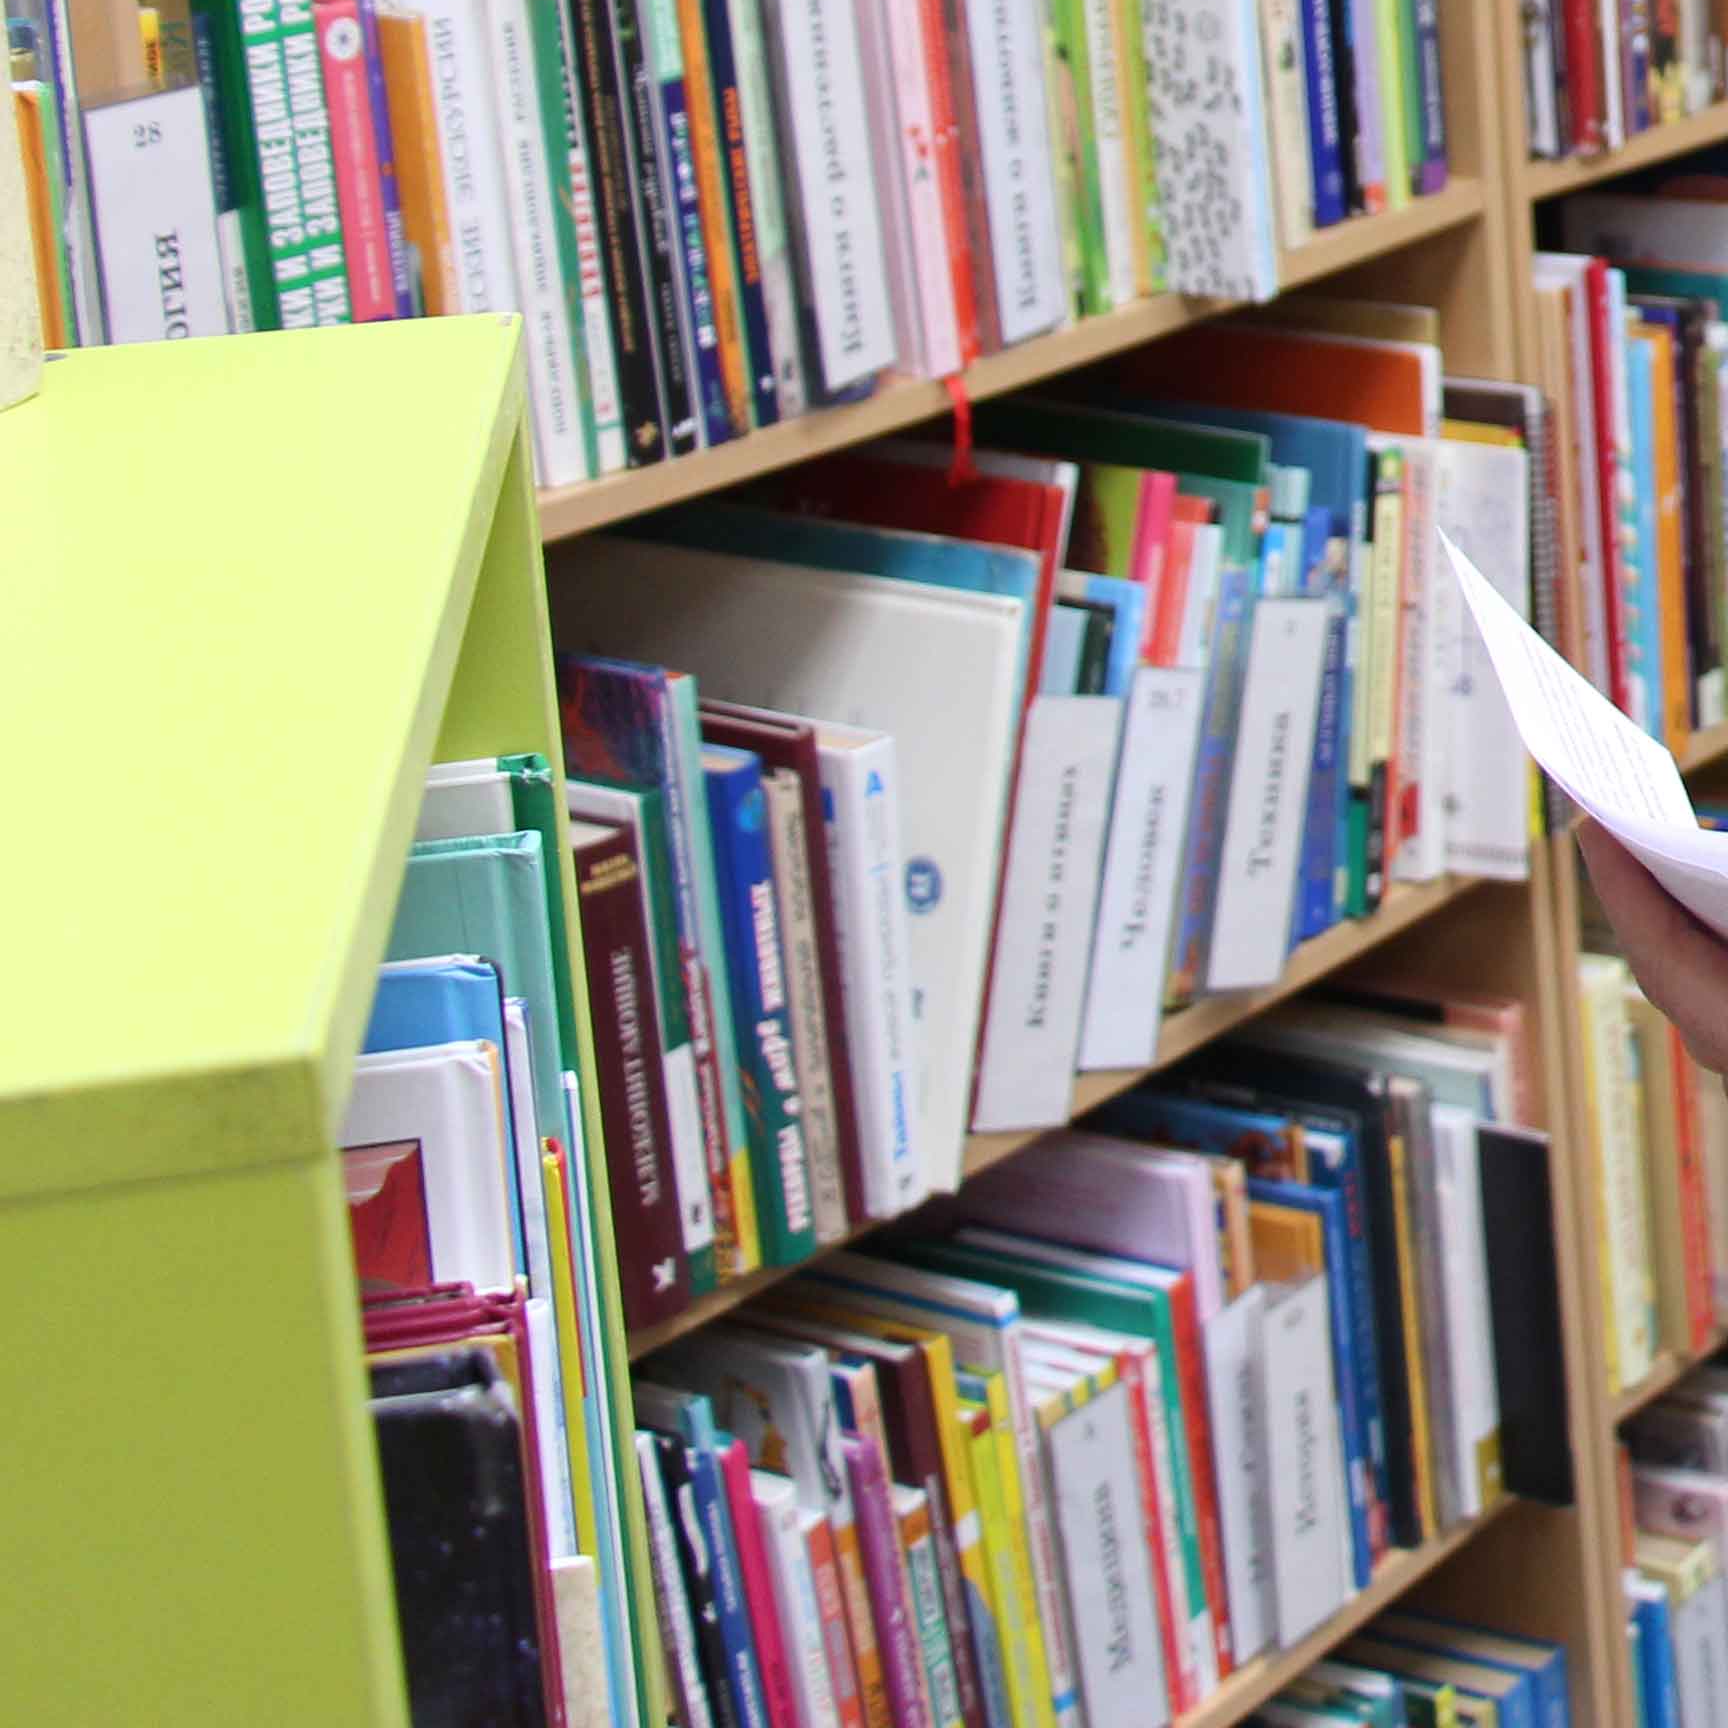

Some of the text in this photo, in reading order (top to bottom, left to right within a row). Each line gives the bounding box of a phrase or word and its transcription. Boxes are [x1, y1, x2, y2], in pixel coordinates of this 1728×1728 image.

[134, 122, 162, 150] 28
[245, 41, 305, 247] ЗАПОВЕДНИКИ
[282, 33, 339, 237] ЗАПОВЕДНИКИ
[610, 947, 660, 1207] МЛЕКОПИТАЮЩИЕ
[1091, 1480, 1131, 1673] Медицина
